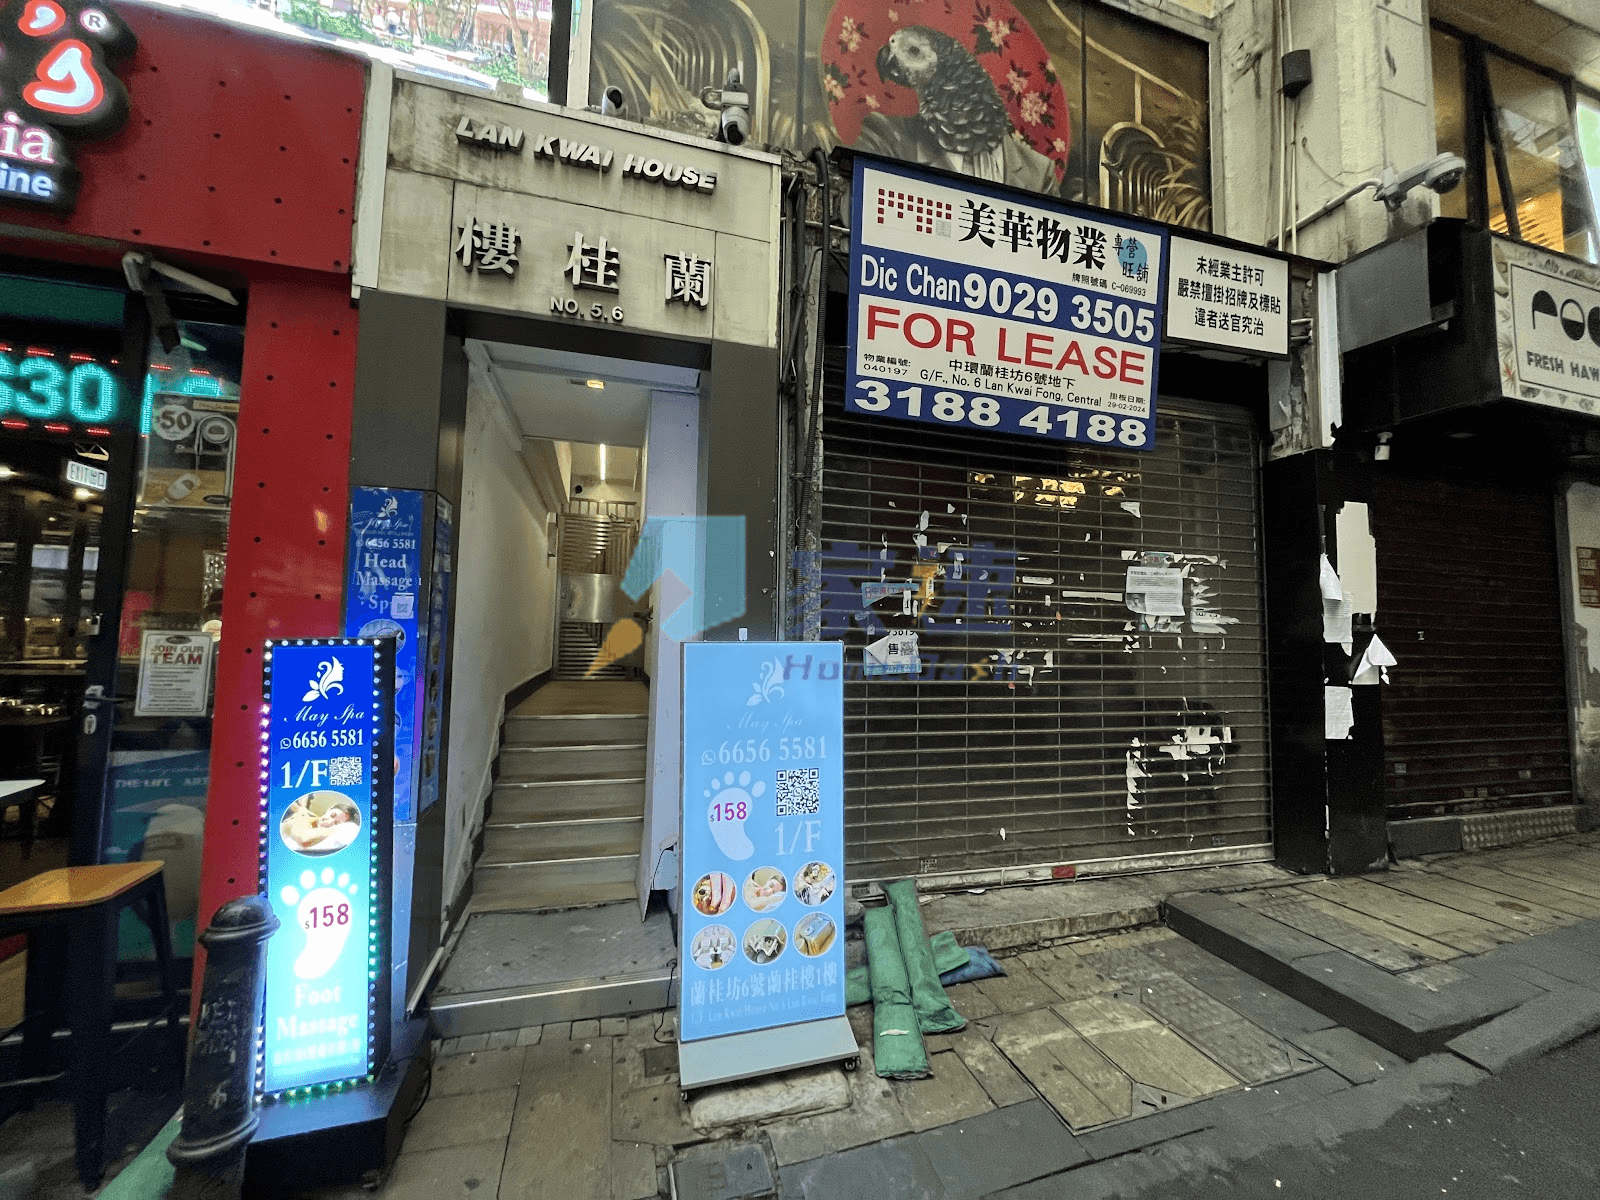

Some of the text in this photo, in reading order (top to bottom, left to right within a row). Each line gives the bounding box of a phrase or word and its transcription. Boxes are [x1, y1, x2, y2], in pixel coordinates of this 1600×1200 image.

[456, 116, 718, 195] LAN KWAI HOUSE
[958, 198, 1108, 271] 美華物業
[1072, 272, 1147, 297] 牌照號碼 C-069993
[1196, 256, 1265, 287] 未經業主許可
[861, 253, 1155, 343] Dic Chan 9029 3505
[1177, 277, 1281, 315] 嚴禁擅掛招牌及標貼
[1194, 306, 1264, 337] 違者送官究治
[867, 304, 1146, 386] FOR LEASE
[863, 363, 908, 376] 040197
[948, 358, 1076, 390] 中環蘭桂坊6號地下
[1526, 350, 1565, 375] FRESH
[920, 368, 1102, 407] G/F., No. 6 Lan Kwai Fong, Central
[854, 380, 1148, 447] 3188 4188
[1107, 401, 1146, 413] 29-02-2024
[392, 538, 416, 550] 5581
[363, 552, 407, 568] Head
[367, 594, 392, 614] Sp
[151, 645, 177, 654] JOIN
[151, 653, 203, 665] TEAM
[289, 704, 365, 728] May Spa
[293, 728, 364, 749] 6656 5581
[718, 735, 828, 765] 6656 5581
[280, 759, 329, 789] 1/F
[774, 819, 821, 857] 1/F
